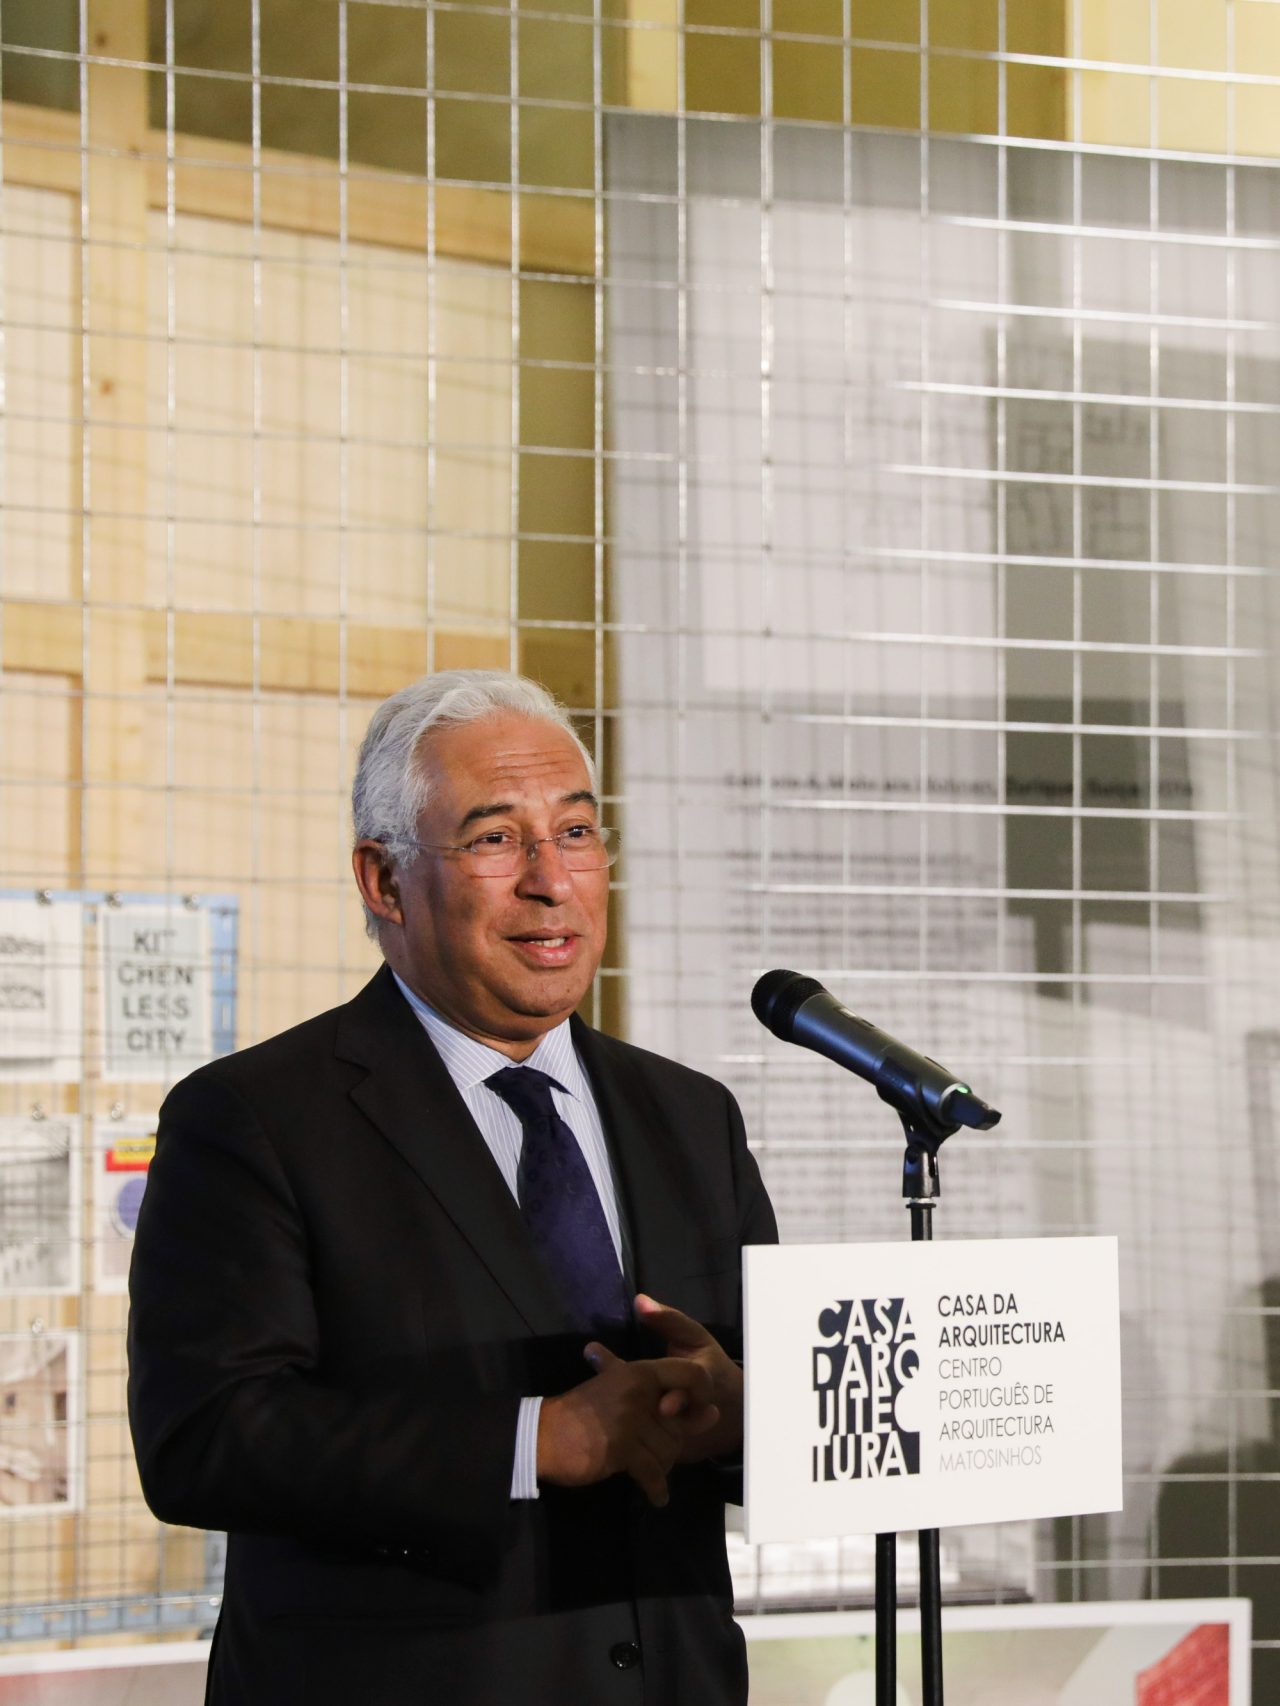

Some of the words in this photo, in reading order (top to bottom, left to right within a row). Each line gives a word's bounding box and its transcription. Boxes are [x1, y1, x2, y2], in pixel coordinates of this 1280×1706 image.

[133, 927, 177, 956] KIT
[116, 959, 194, 987] CHEN
[120, 993, 191, 1020] LESS
[125, 1027, 186, 1053] CITY
[937, 1293, 987, 1317] CASA
[993, 1292, 1019, 1315] DA
[817, 1297, 917, 1347] CASA
[938, 1321, 1066, 1348] ARQUITECTURA
[938, 1356, 1002, 1380] CENTRO
[938, 1381, 1029, 1411] PORTUGUÊS
[1034, 1384, 1054, 1405] DE
[938, 1415, 1055, 1441] ARQUITECTURA
[813, 1431, 912, 1483] TURA
[938, 1445, 1042, 1473] MATOSINHOS
